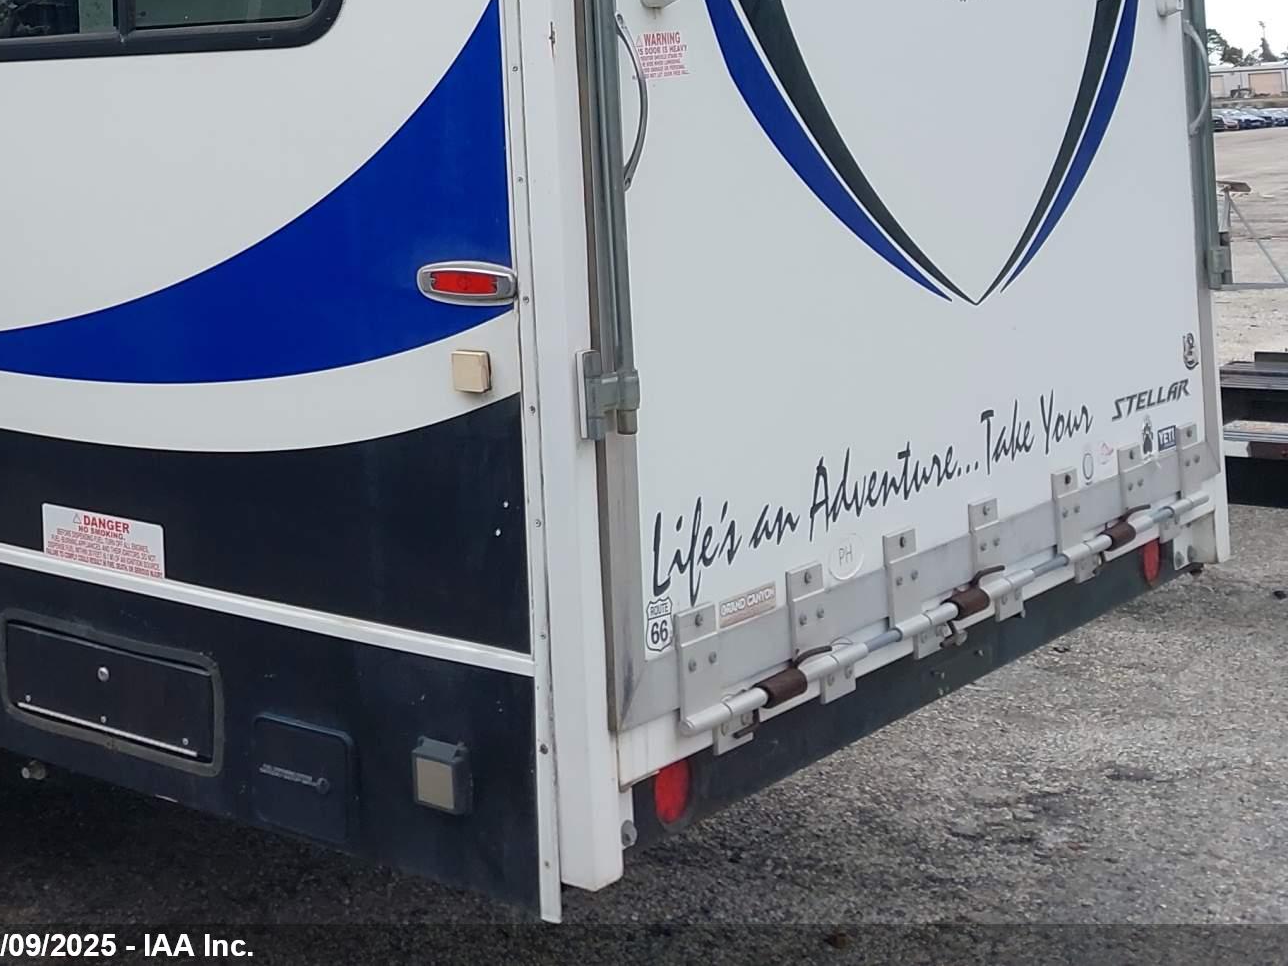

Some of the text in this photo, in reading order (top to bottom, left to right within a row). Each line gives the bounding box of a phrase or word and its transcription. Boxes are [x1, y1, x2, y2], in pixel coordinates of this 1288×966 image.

[643, 32, 680, 46] WARNING
[645, 46, 661, 55] DOOR
[662, 45, 668, 54] IS
[669, 44, 688, 53] HEAVY
[650, 495, 743, 607] Life's
[748, 503, 800, 549] an
[1040, 389, 1093, 455] Your
[1111, 378, 1190, 422] STELLAR
[78, 525, 89, 534] NO
[83, 514, 130, 535] DANGER
[649, 602, 669, 616] ROUTE
[651, 619, 669, 645] 66
